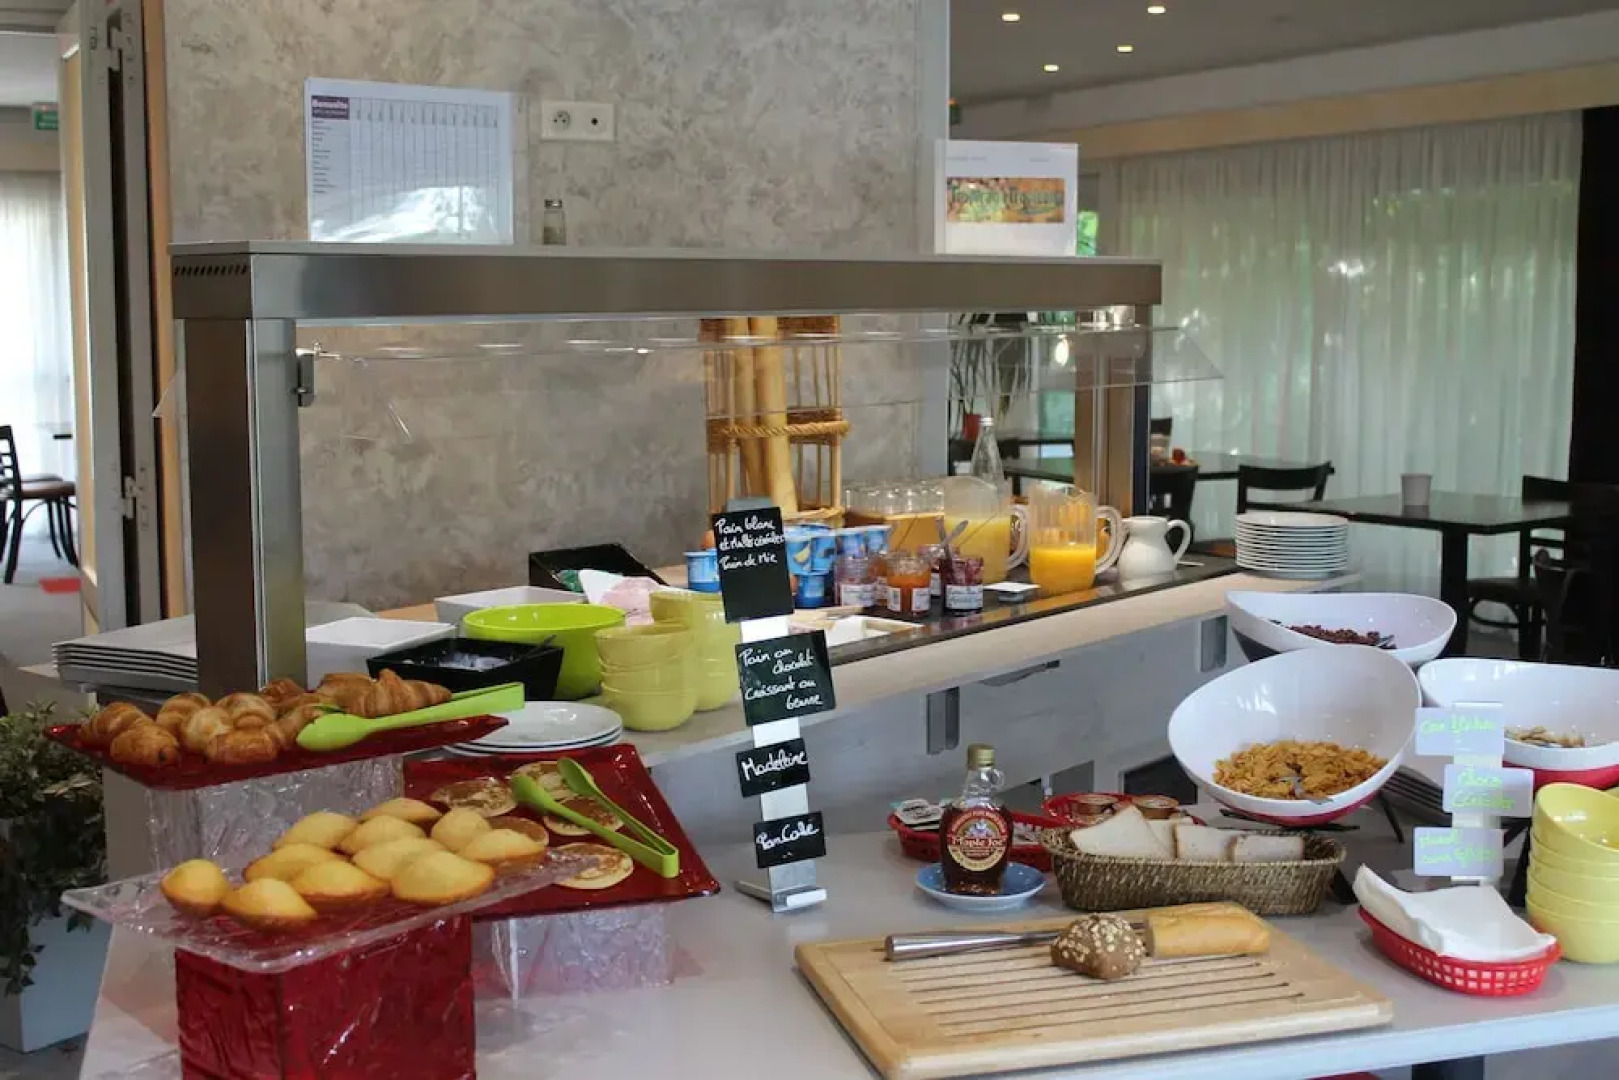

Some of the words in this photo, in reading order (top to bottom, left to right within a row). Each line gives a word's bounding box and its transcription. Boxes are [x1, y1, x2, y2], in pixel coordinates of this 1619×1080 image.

[739, 648, 771, 667] Pain
[774, 648, 794, 658] au
[799, 680, 817, 689] au
[741, 749, 809, 781] Madeleine
[951, 835, 986, 848] Maple
[987, 836, 1004, 847] Joe
